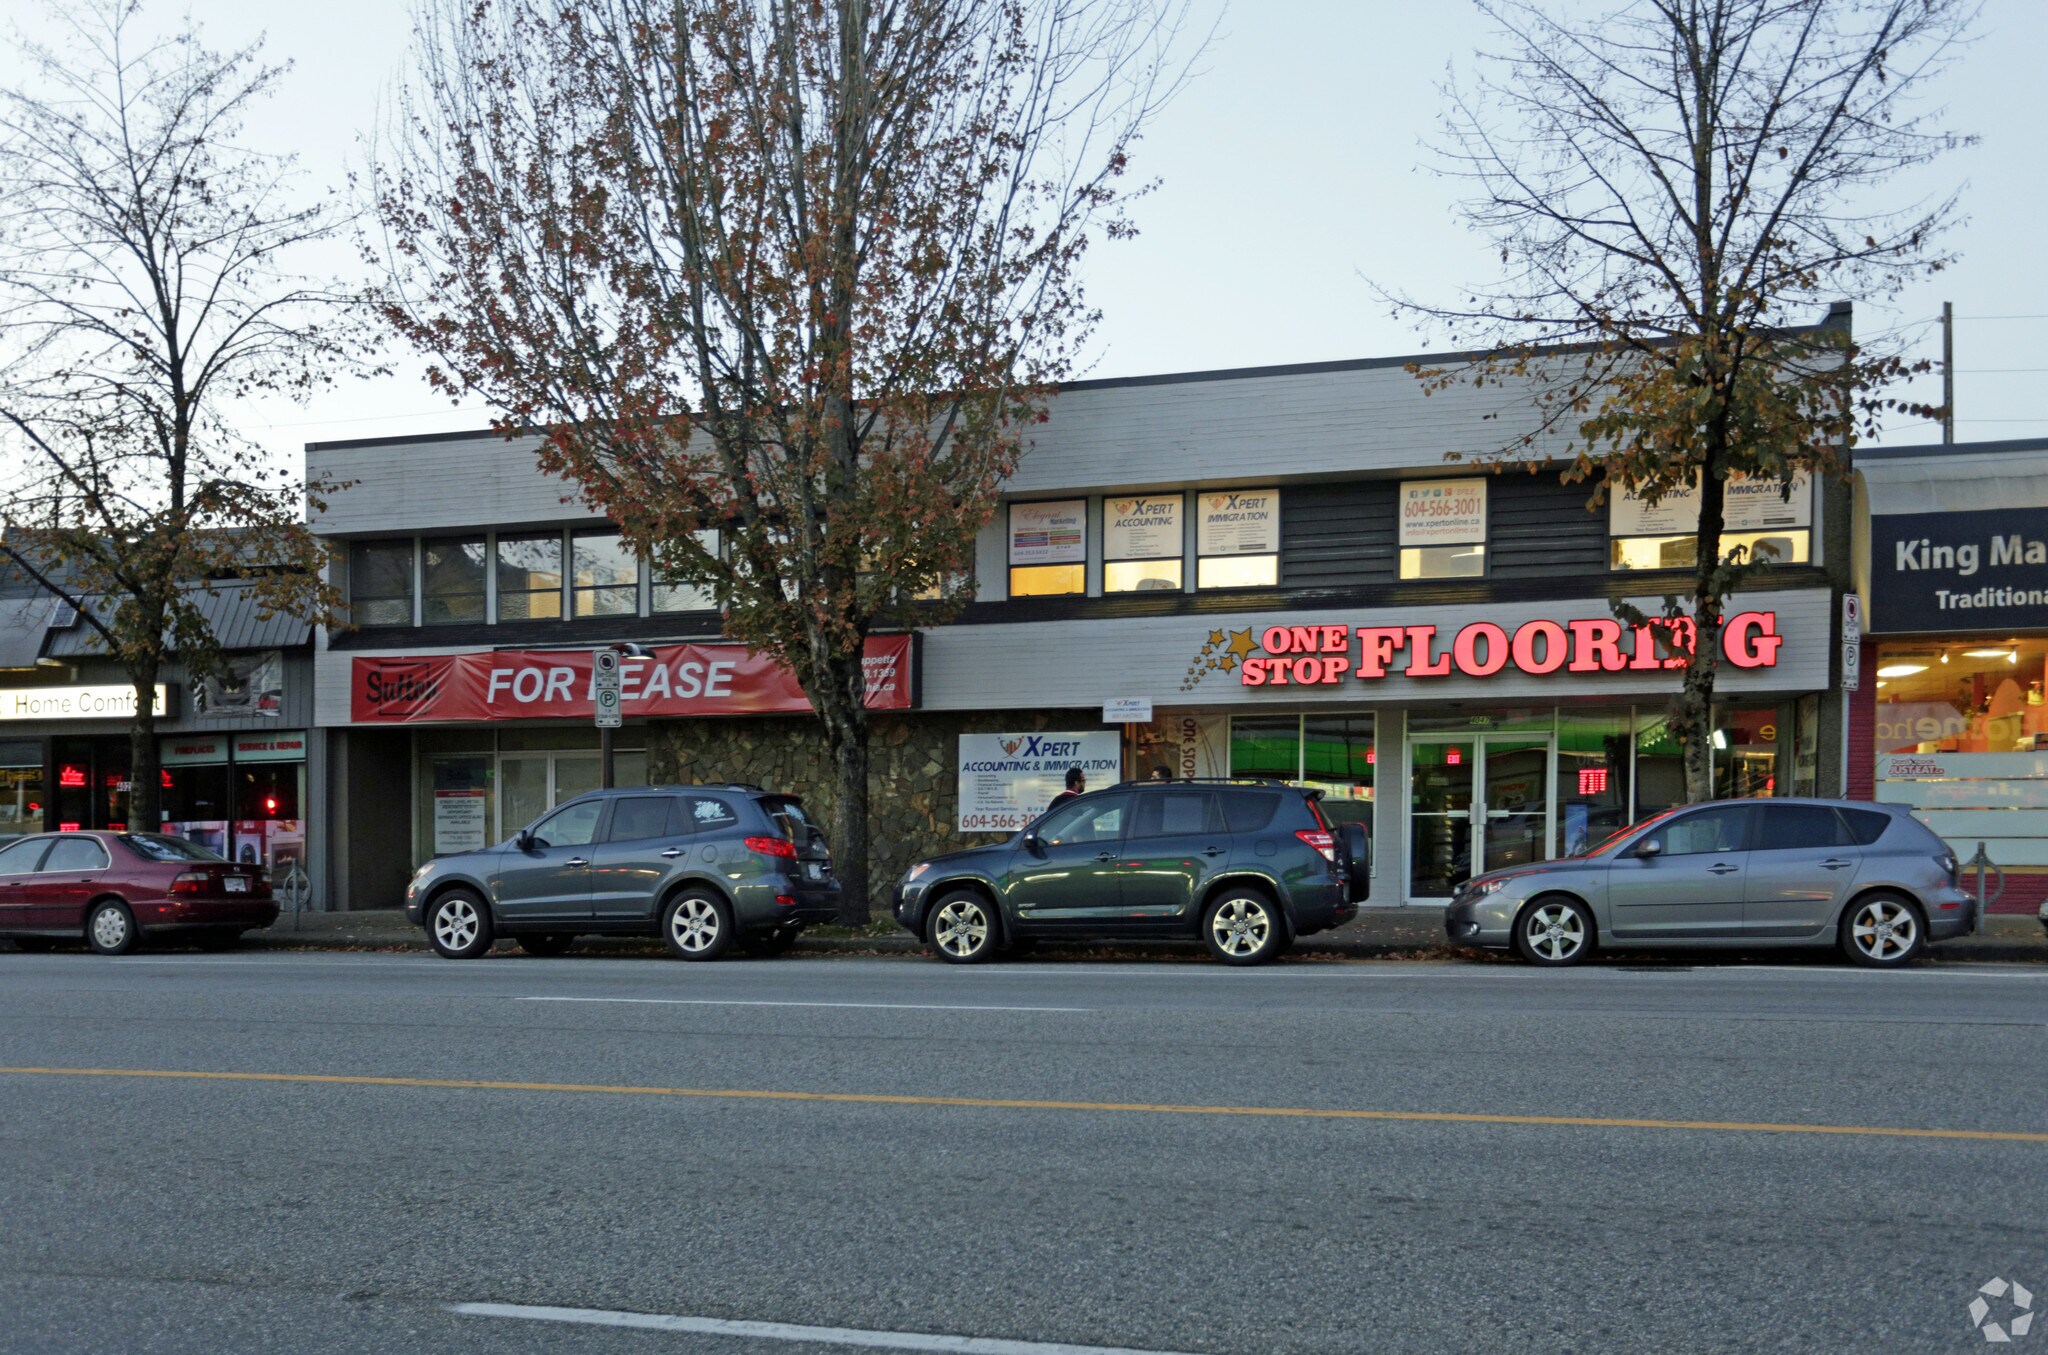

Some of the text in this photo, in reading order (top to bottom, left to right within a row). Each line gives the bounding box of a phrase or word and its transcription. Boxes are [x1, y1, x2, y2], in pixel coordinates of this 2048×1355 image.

[1132, 500, 1174, 515] XPERT
[1226, 495, 1267, 510] XPERT
[1404, 498, 1481, 517] 604-566-3001
[1114, 517, 1173, 527] ACCOUNTING
[1207, 512, 1268, 522] IMMIGRATION
[1405, 518, 1479, 528] www.xpertonline.ca
[1896, 538, 1979, 575] King
[1262, 625, 1348, 654] ONE
[1242, 657, 1349, 686] STOP
[366, 670, 440, 702] Sutton
[487, 667, 575, 703] FOR
[15, 695, 71, 713] Home
[238, 743, 267, 751] SERVICE
[276, 741, 302, 750] REPAIR
[1023, 736, 1080, 756] XPERT
[962, 760, 1117, 771] ACCOUNTING & IMMIGRATION
[1182, 747, 1196, 778] STOP
